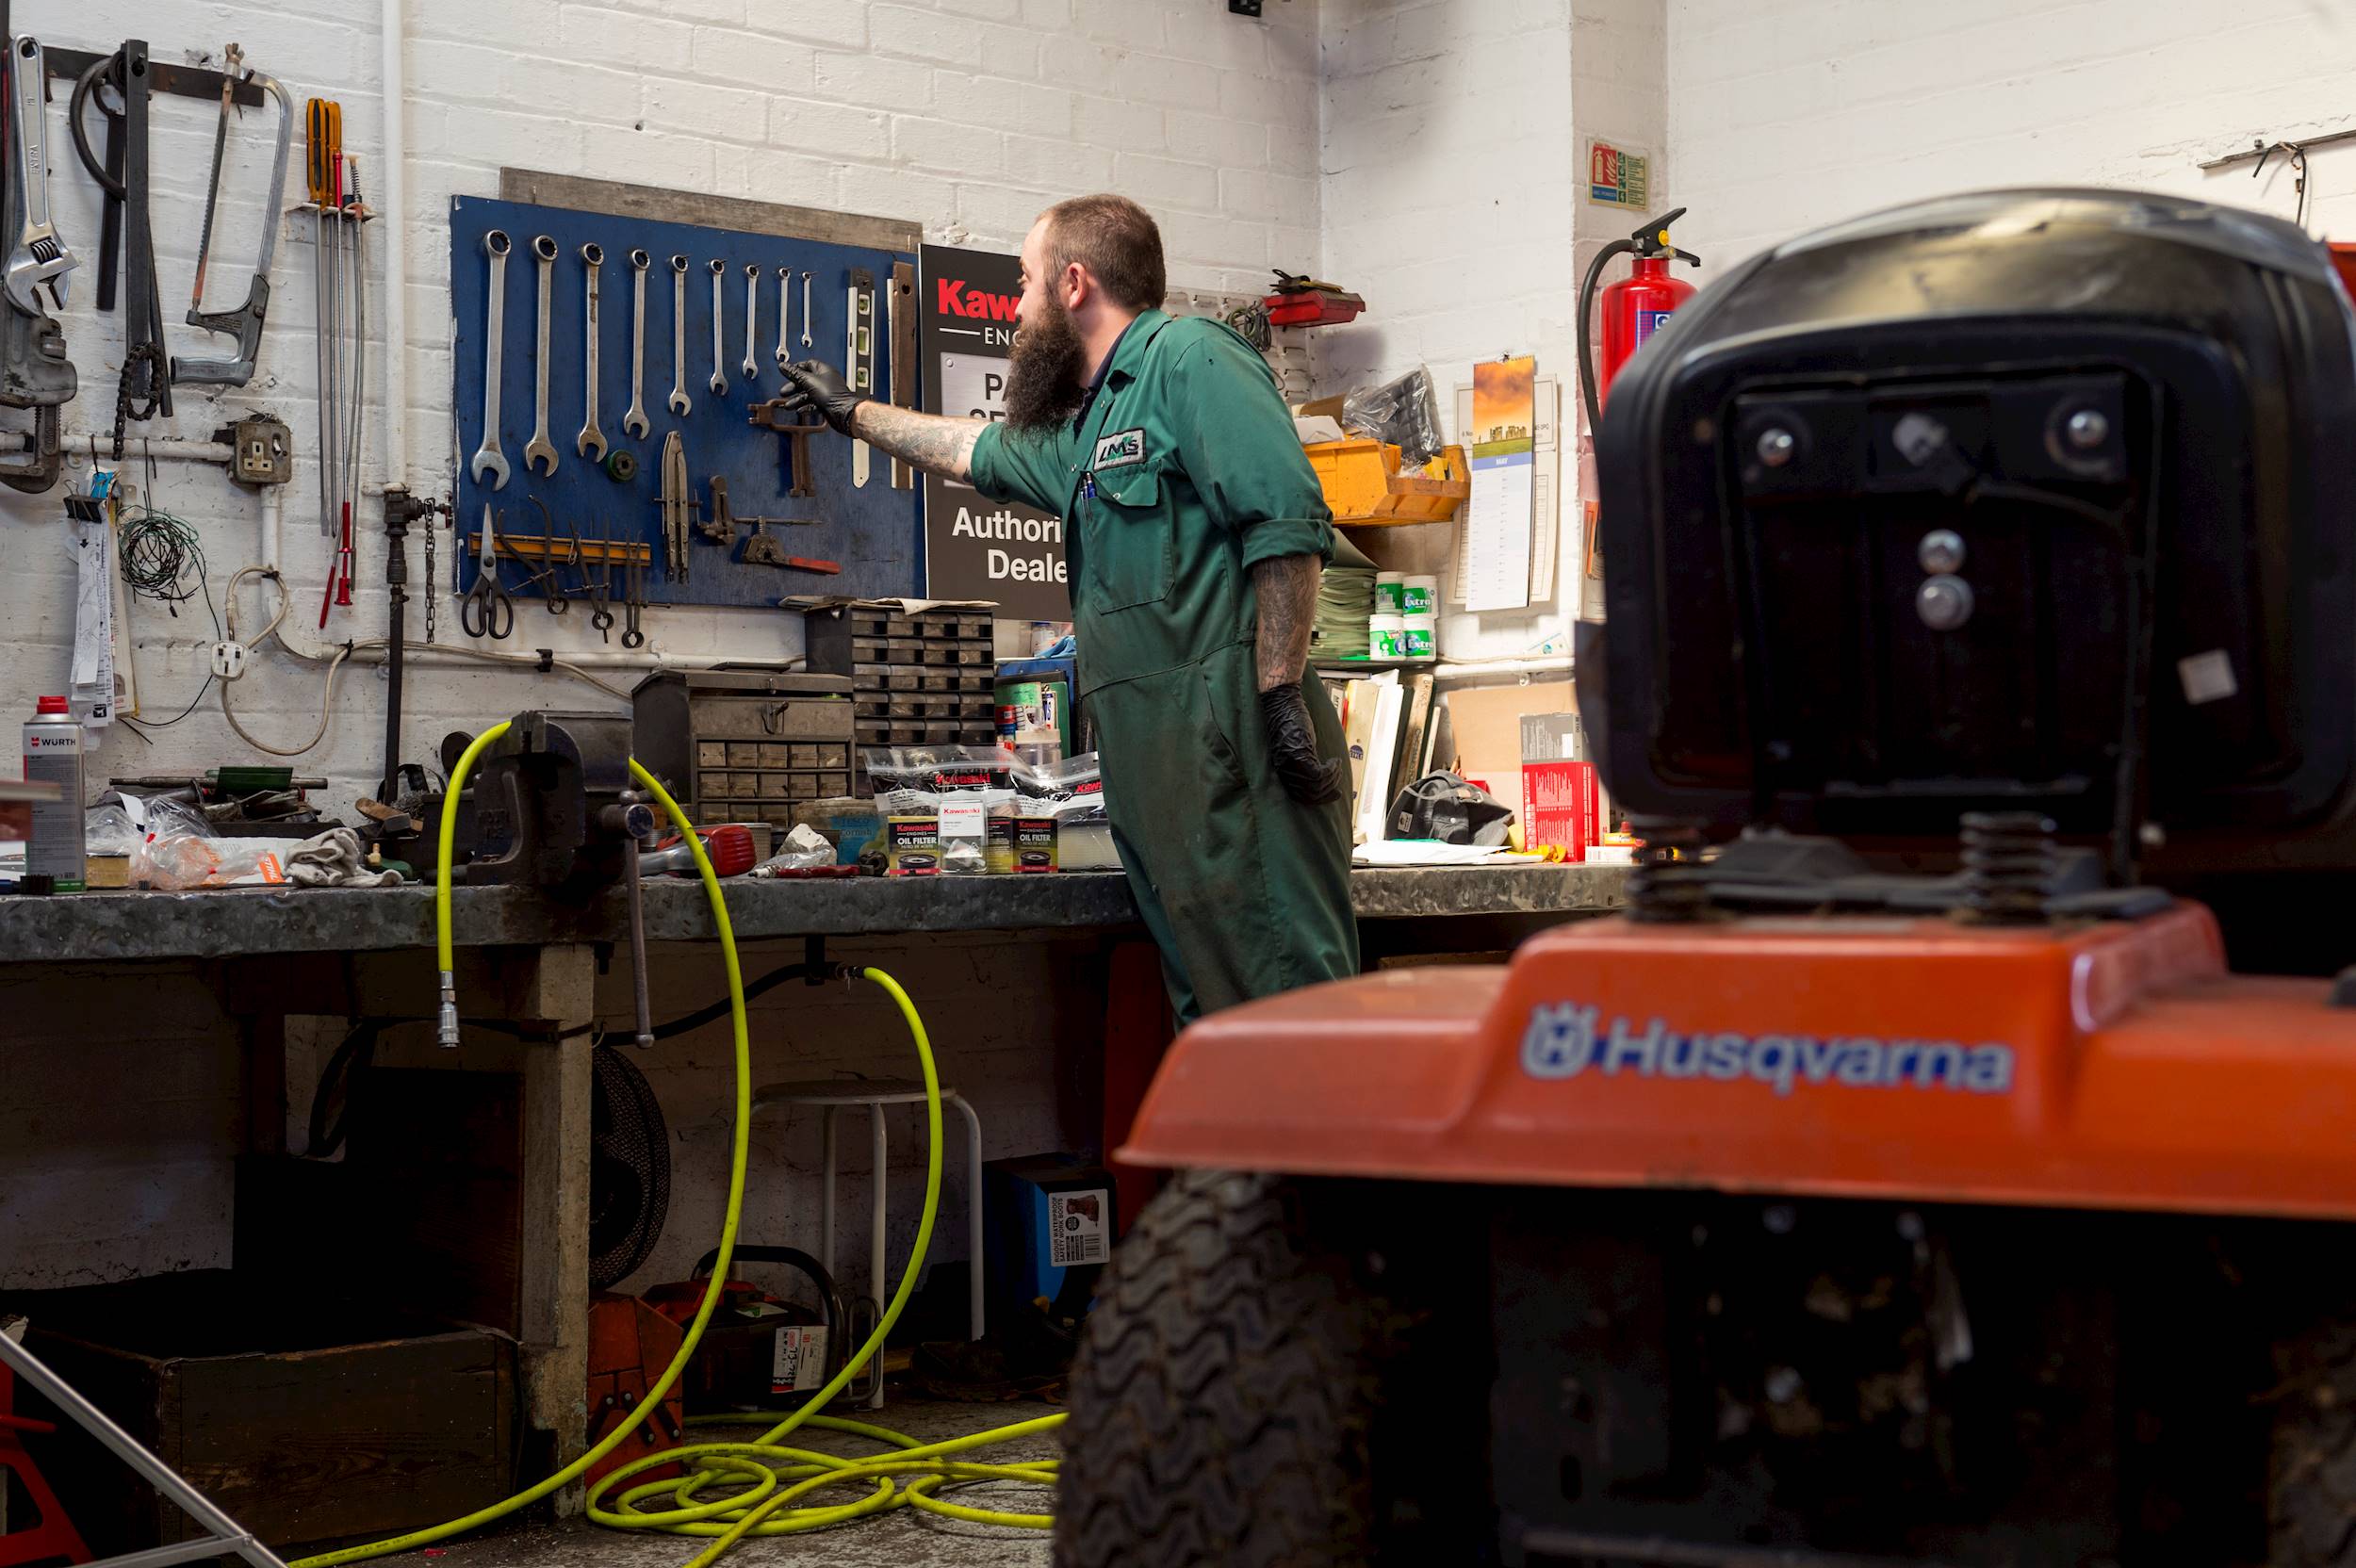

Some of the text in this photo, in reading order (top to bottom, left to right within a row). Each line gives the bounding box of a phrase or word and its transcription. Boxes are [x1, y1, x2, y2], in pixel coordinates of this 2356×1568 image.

[938, 278, 1023, 322] Kaw
[952, 507, 1063, 543] Authori
[1405, 596, 1432, 607] Extra
[1408, 639, 1433, 649] Extra
[897, 824, 937, 832] Kawasaki
[897, 836, 937, 845] OIL FILTER
[264, 857, 277, 880] STIHL
[1602, 1017, 2015, 1096] Husqvarna
